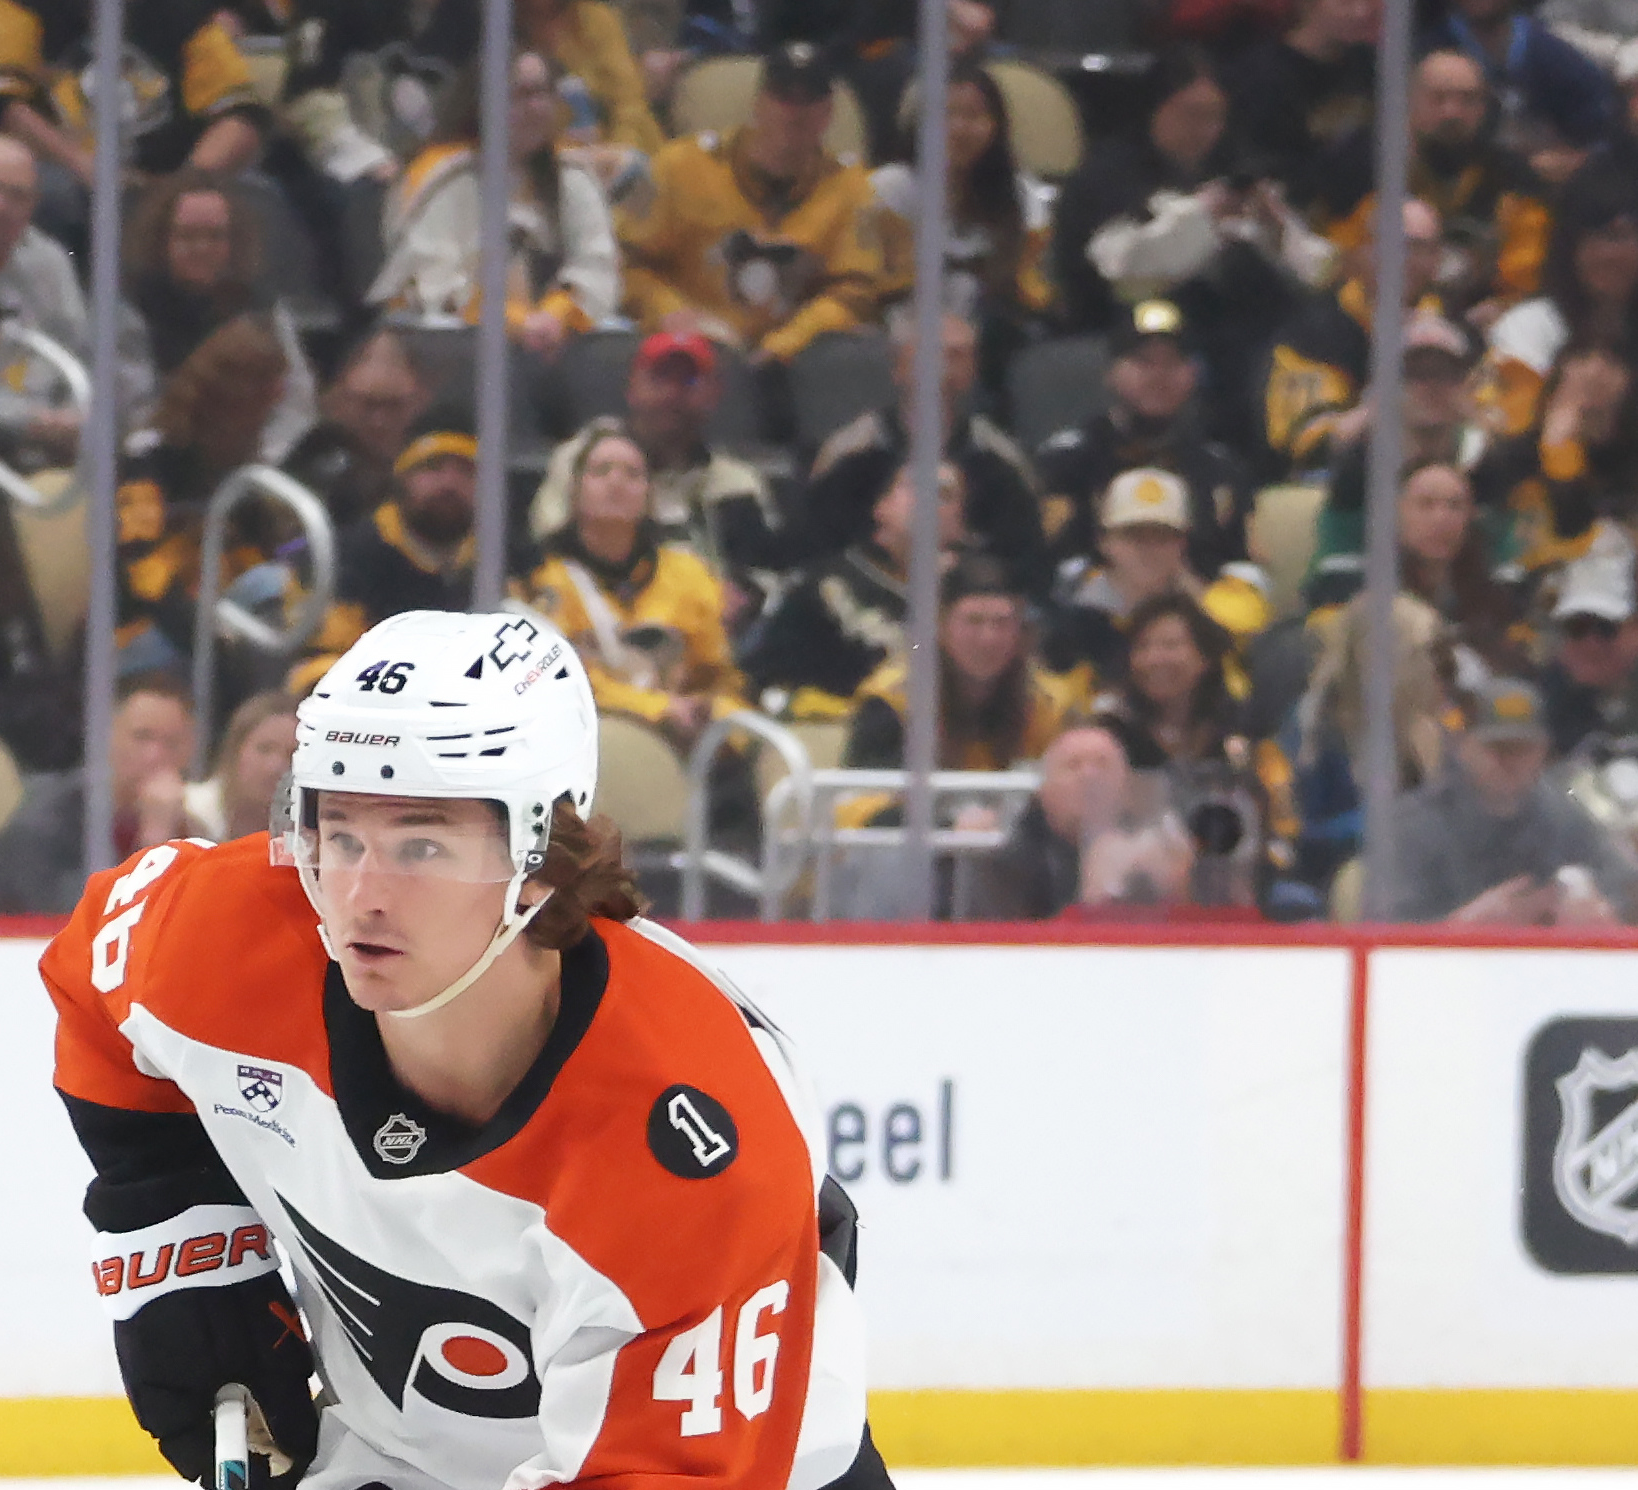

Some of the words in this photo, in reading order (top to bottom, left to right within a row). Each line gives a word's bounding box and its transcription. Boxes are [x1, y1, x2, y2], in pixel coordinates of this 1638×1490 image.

[356, 660, 416, 695] 46
[514, 643, 564, 696] CHEVROLET
[325, 730, 401, 747] BAUER
[667, 1092, 731, 1167] 1
[92, 1223, 272, 1297] AUER
[652, 1278, 791, 1437] 46
